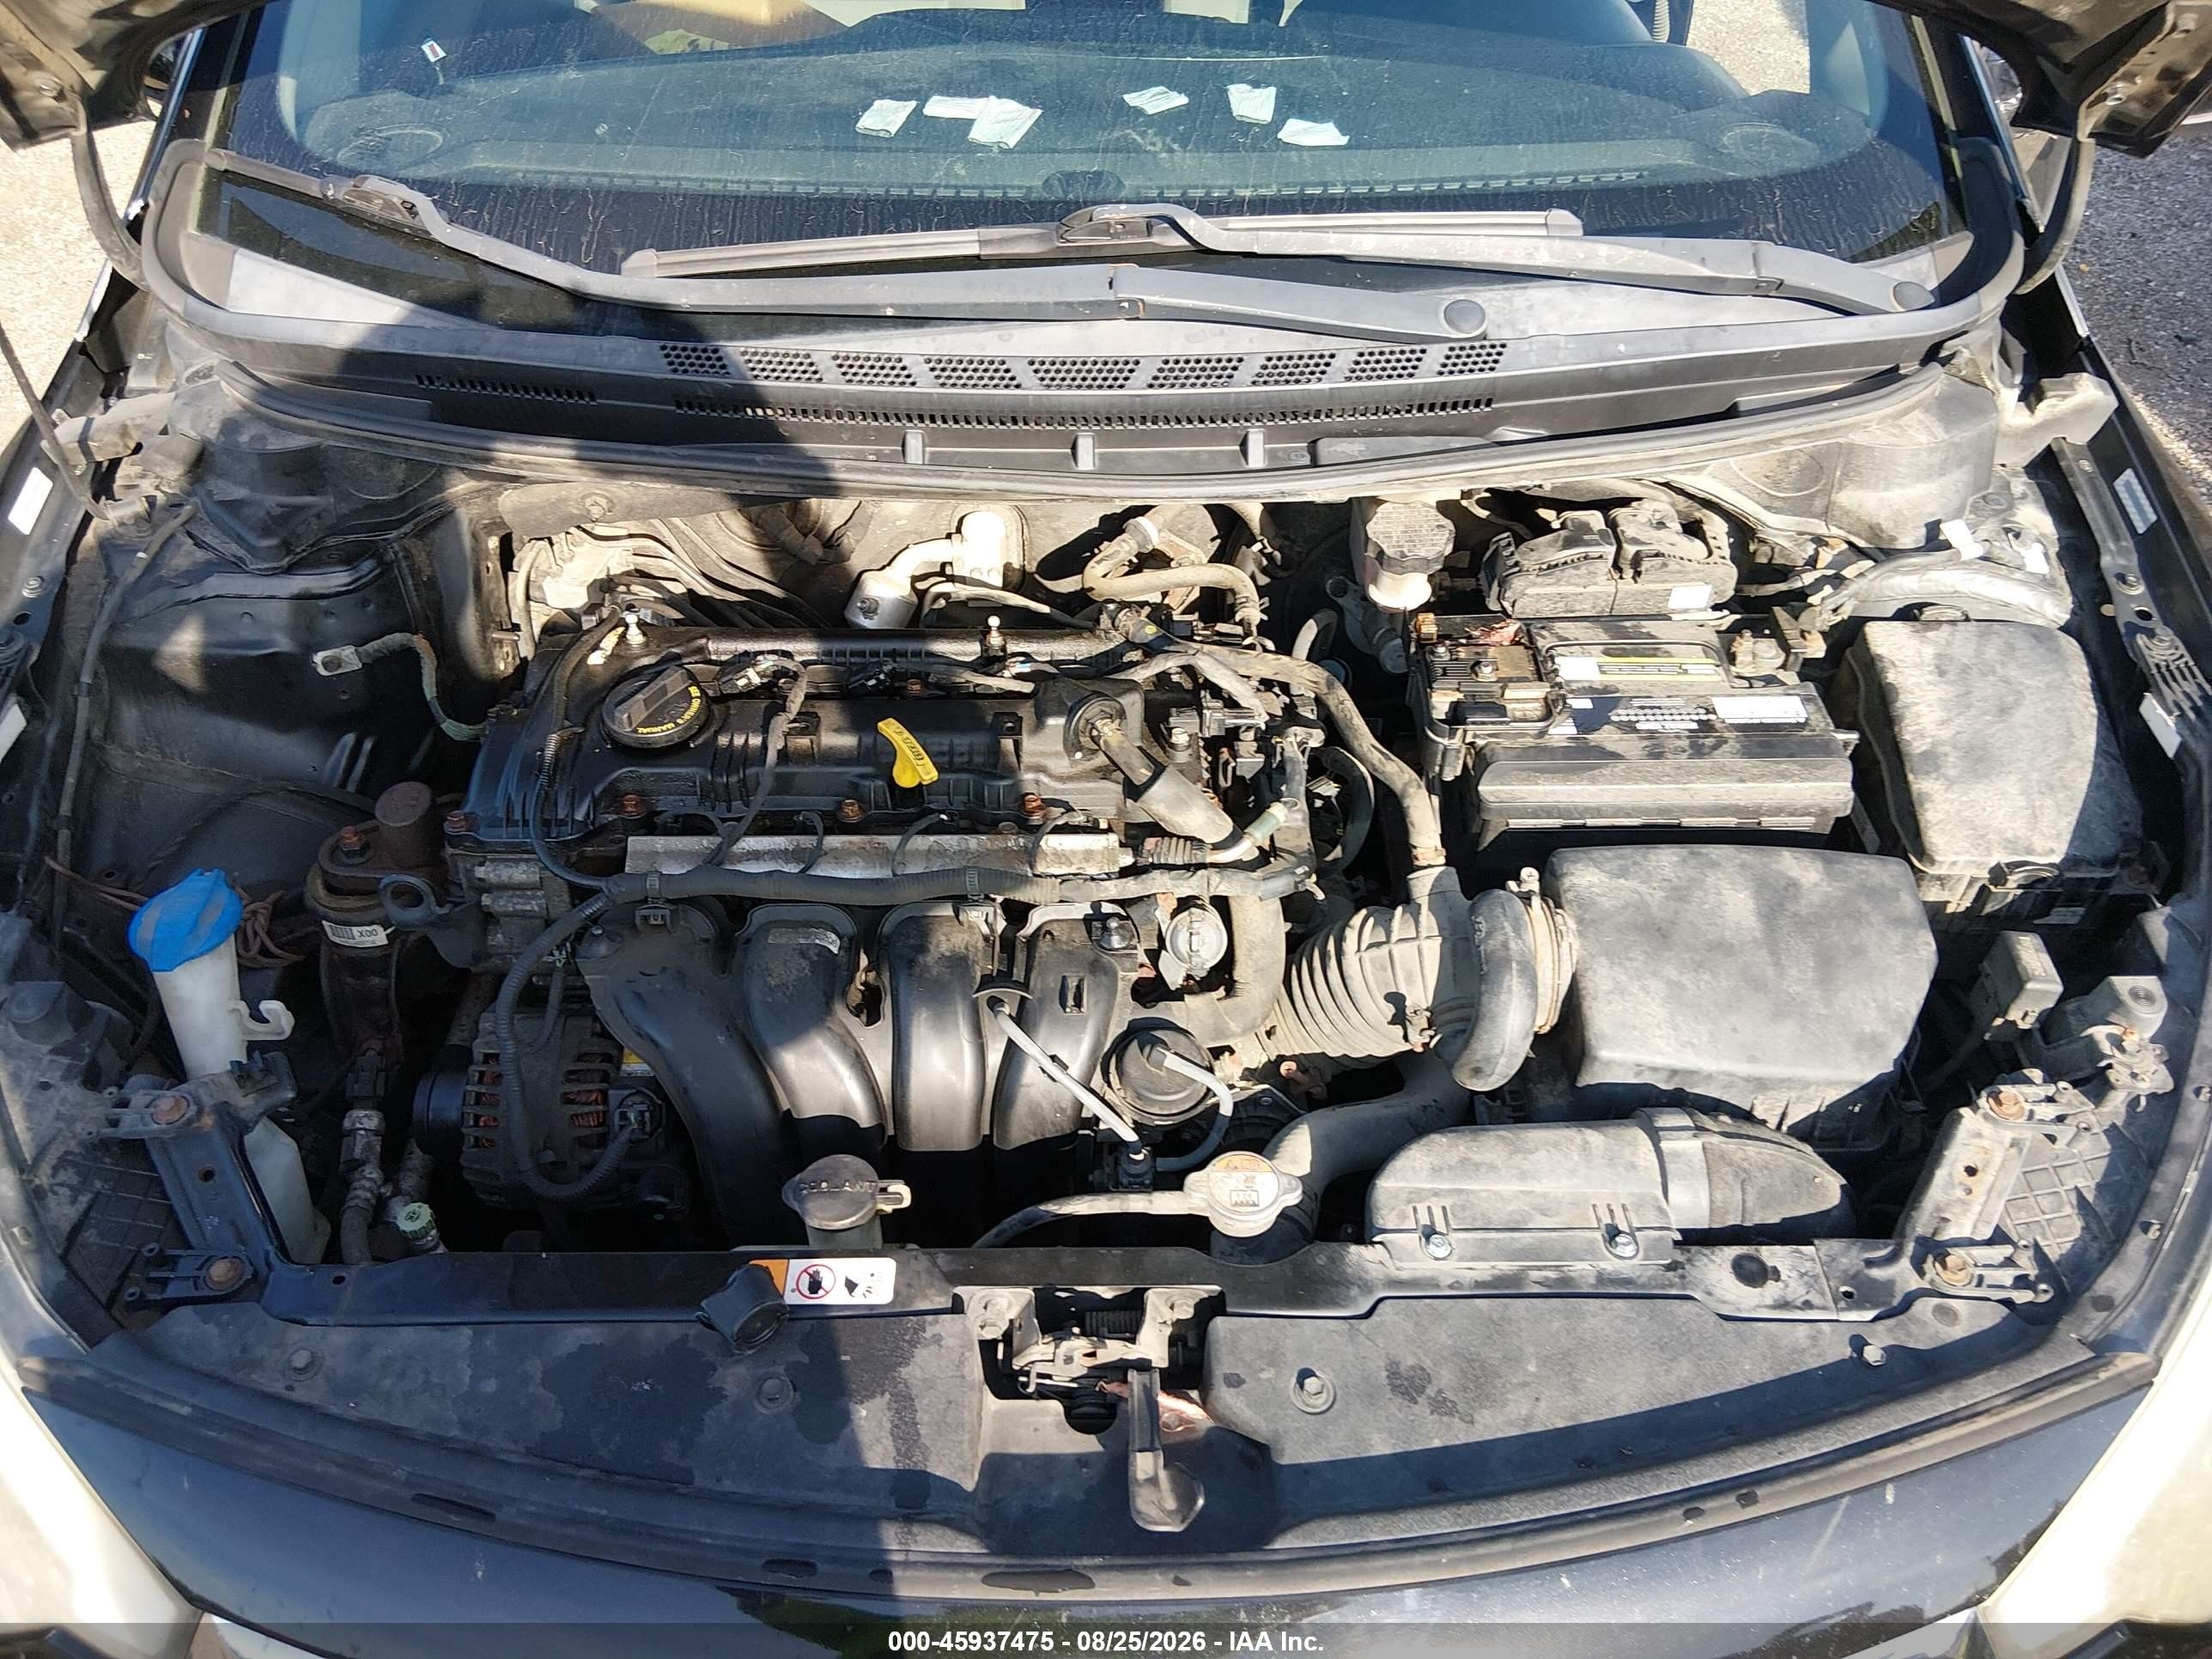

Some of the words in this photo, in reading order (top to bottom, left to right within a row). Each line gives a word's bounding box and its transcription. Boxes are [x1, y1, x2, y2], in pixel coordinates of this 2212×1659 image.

[676, 698, 701, 724] OWNER'S
[636, 722, 676, 733] MANUAL
[799, 1180, 877, 1195] COOLANT
